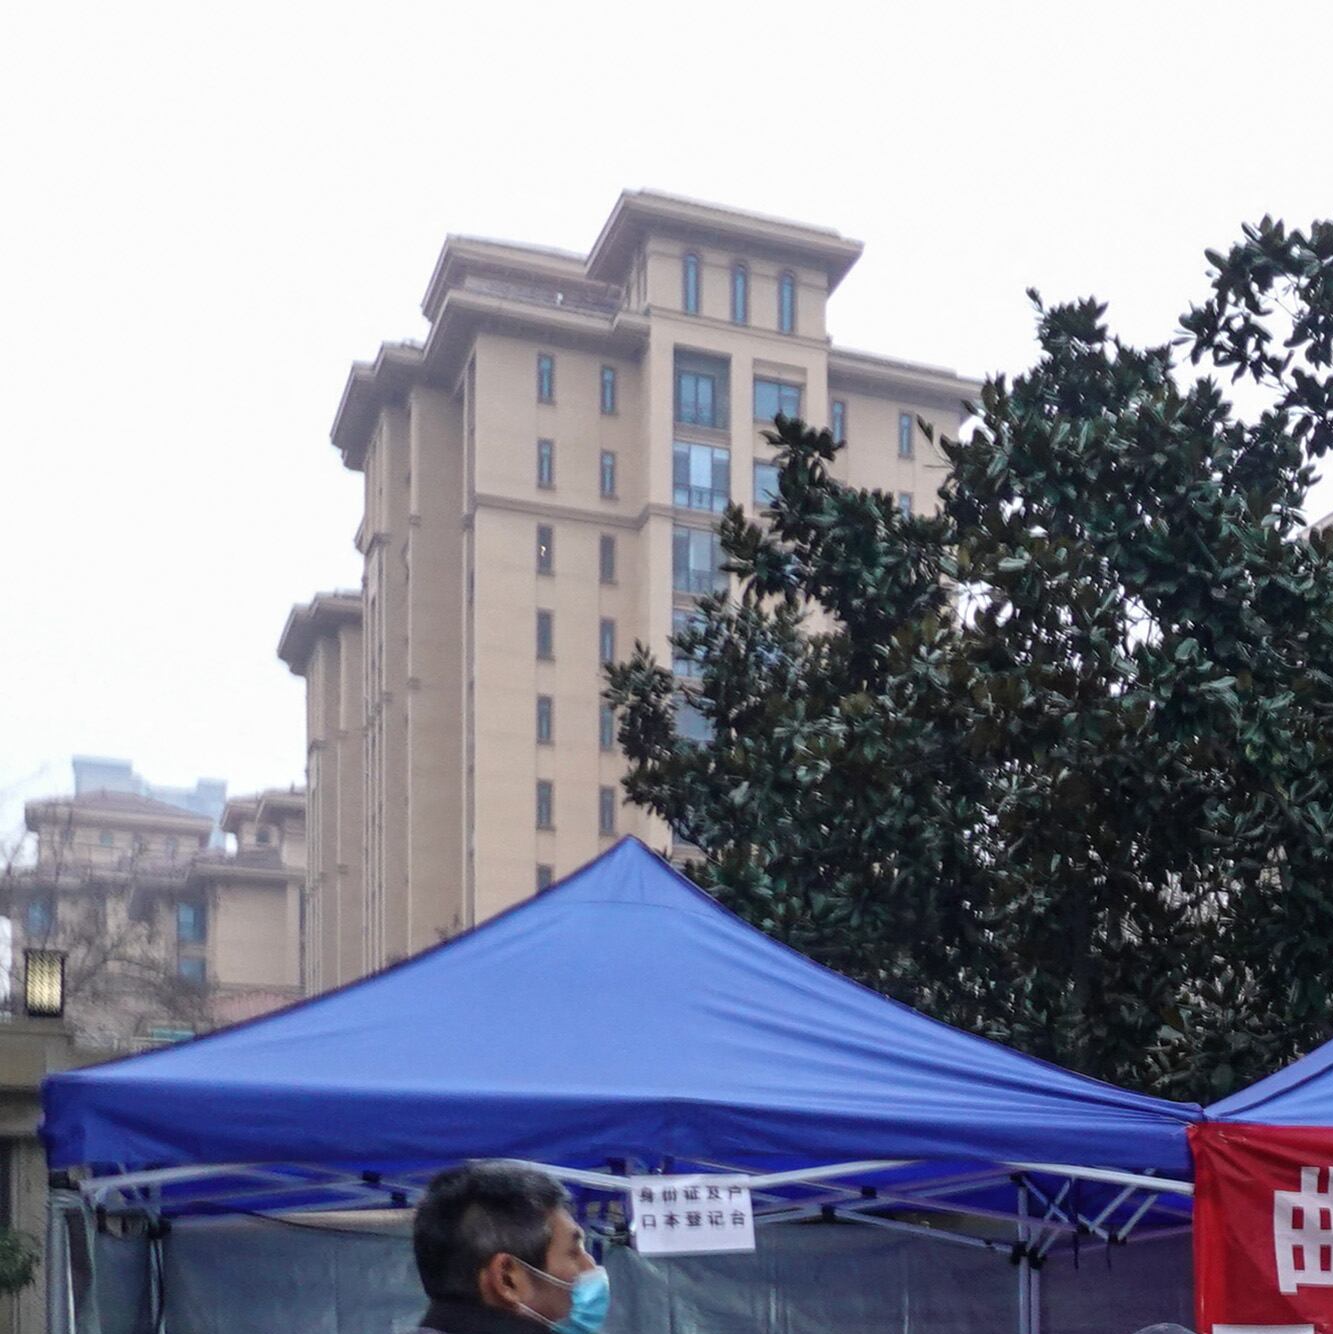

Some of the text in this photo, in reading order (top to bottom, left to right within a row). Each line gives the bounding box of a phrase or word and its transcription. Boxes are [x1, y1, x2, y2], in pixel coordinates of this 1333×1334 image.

[639, 1186, 742, 1203] 身份证及户
[642, 1210, 745, 1228] 口本登记台
